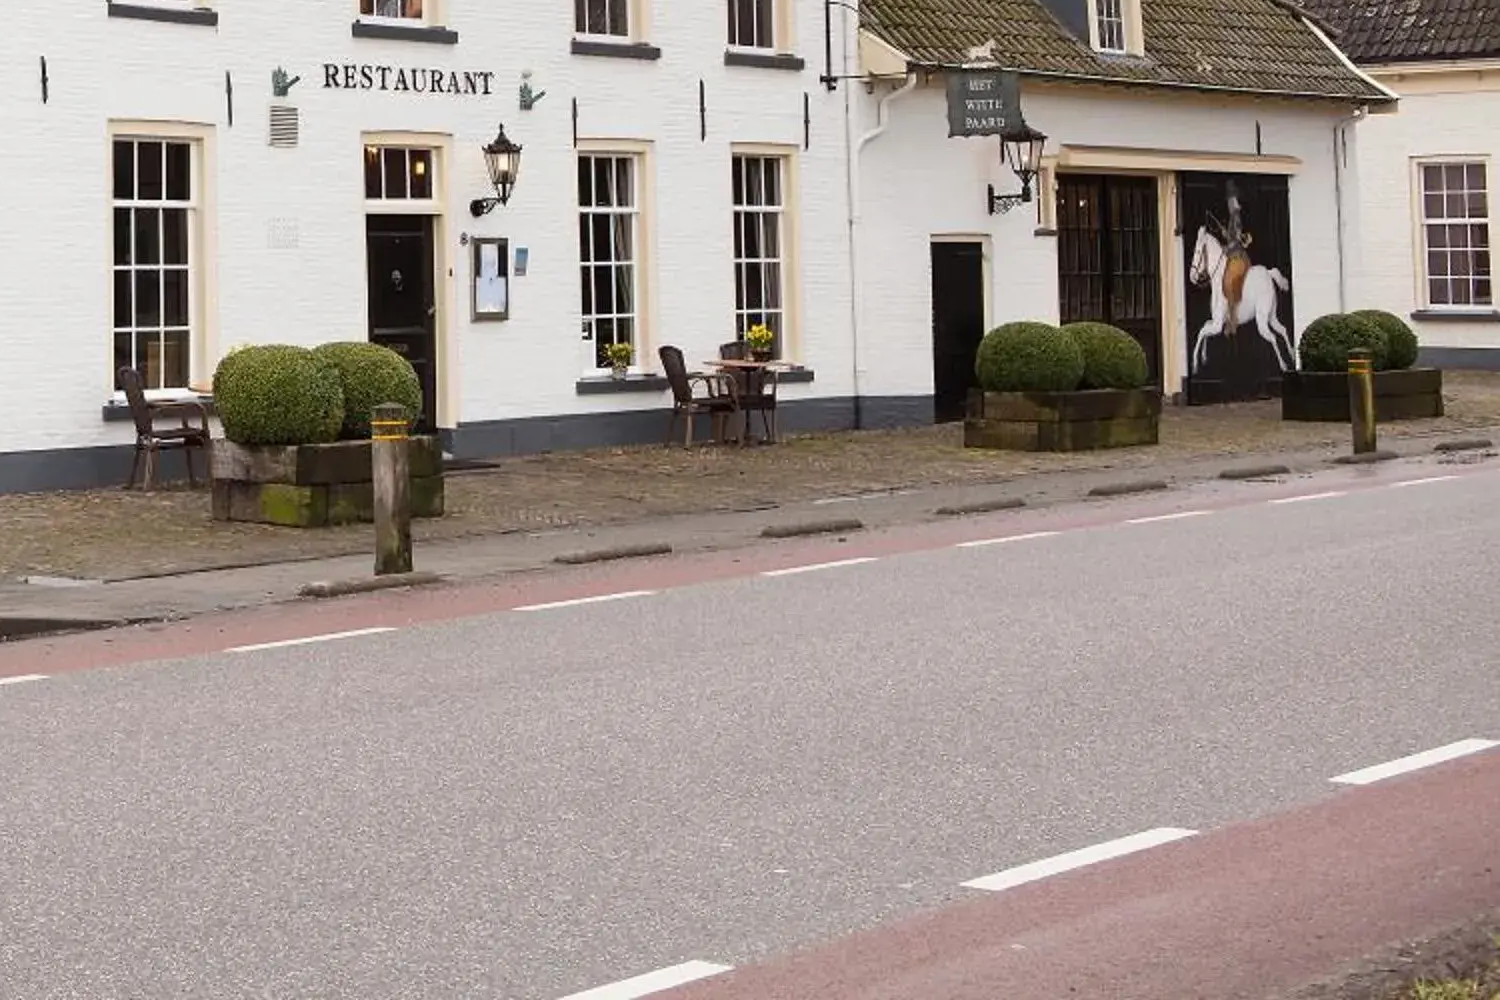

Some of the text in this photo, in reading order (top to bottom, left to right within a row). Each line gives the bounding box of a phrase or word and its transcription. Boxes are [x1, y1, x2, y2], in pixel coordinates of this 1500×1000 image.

[322, 63, 495, 95] RESTAURANT
[969, 79, 994, 91] HET
[965, 99, 1003, 110] WITTE
[965, 117, 1005, 128] PAARD
